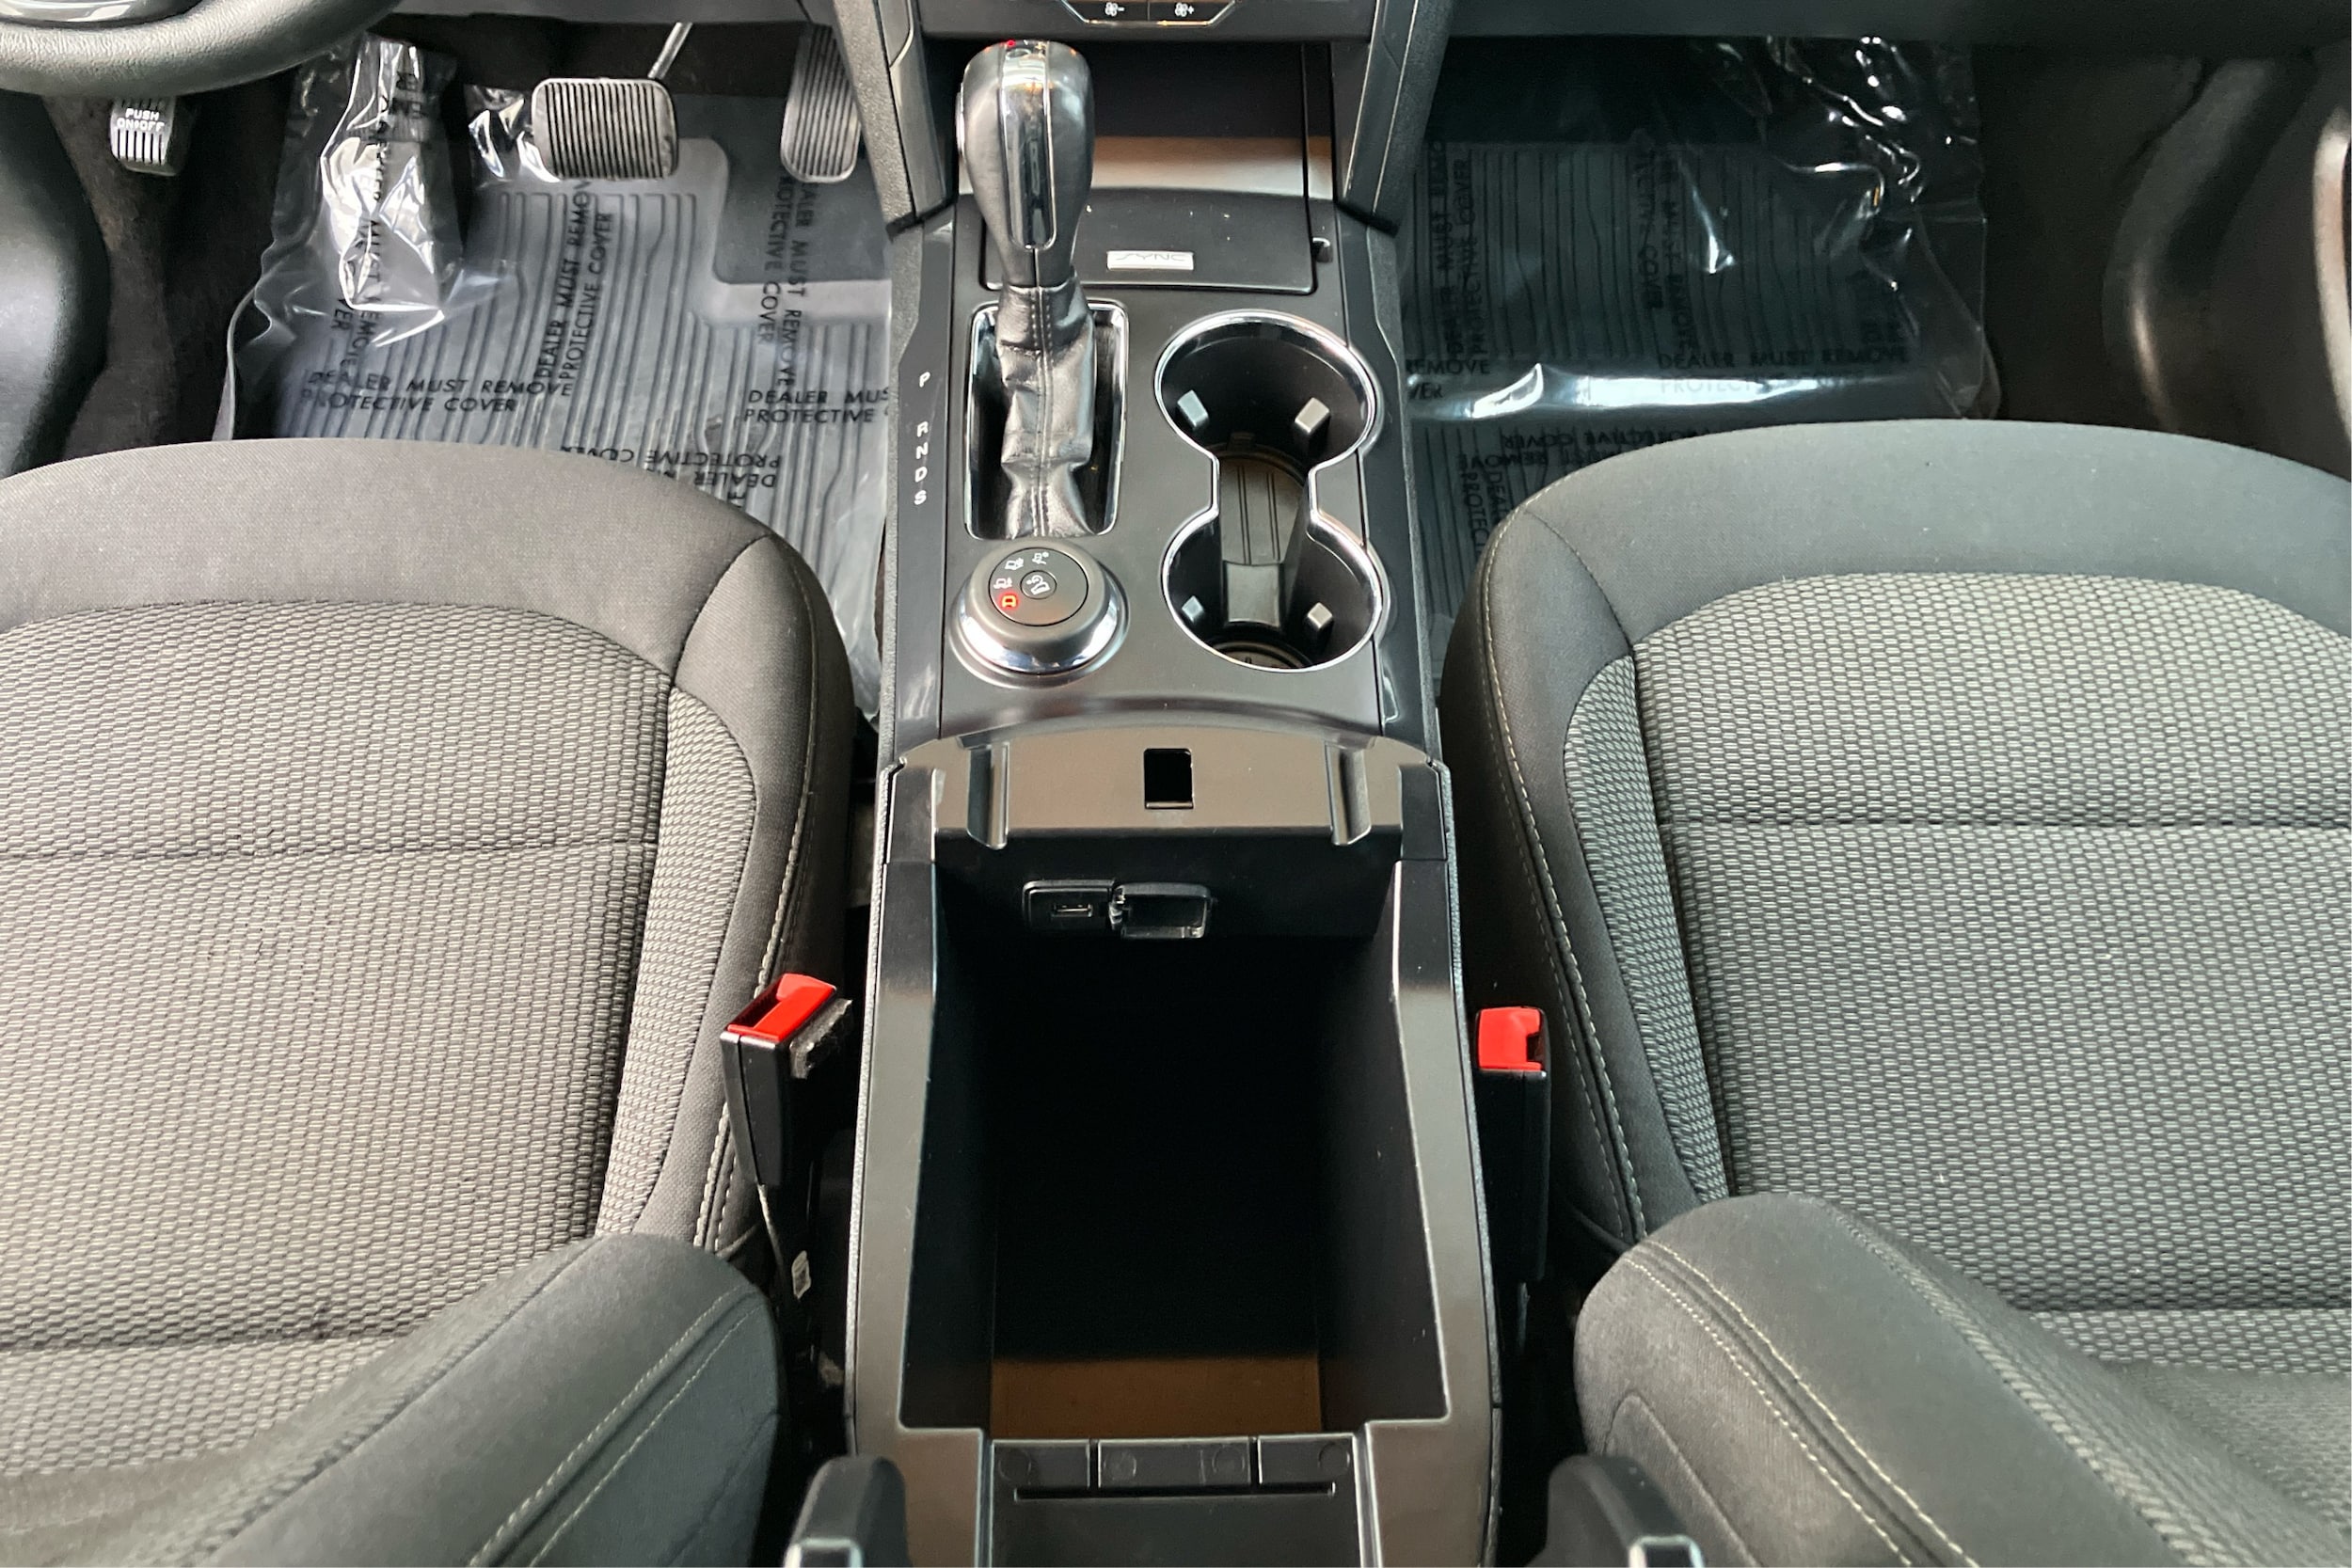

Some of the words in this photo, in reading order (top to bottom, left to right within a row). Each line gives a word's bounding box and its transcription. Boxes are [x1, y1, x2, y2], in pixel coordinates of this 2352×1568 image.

[125, 107, 159, 121] PUSH
[567, 181, 592, 246] REMOV
[795, 182, 819, 228] EALER
[764, 169, 796, 272] ROTECTIVE
[787, 239, 808, 297] MUST
[556, 258, 580, 309] MUST
[559, 283, 600, 380] PROTECTIVE
[588, 212, 614, 276] COVER
[756, 281, 781, 344] COVER
[533, 319, 565, 378] DEALER
[777, 309, 803, 387] REMOVE
[406, 379, 469, 394] MUST
[481, 379, 574, 397] REMOVE
[918, 371, 931, 388] P
[444, 396, 519, 413] COVER
[748, 389, 828, 404] DEALER
[844, 387, 890, 404] MUS
[743, 408, 875, 423] PROTECTIVE
[916, 420, 930, 438] R
[644, 449, 782, 468] PROTECTIVE
[915, 441, 930, 460] N
[693, 470, 777, 488] DEALER
[914, 466, 929, 483] D
[914, 489, 928, 506] S
[1462, 472, 1490, 555] PROTECT
